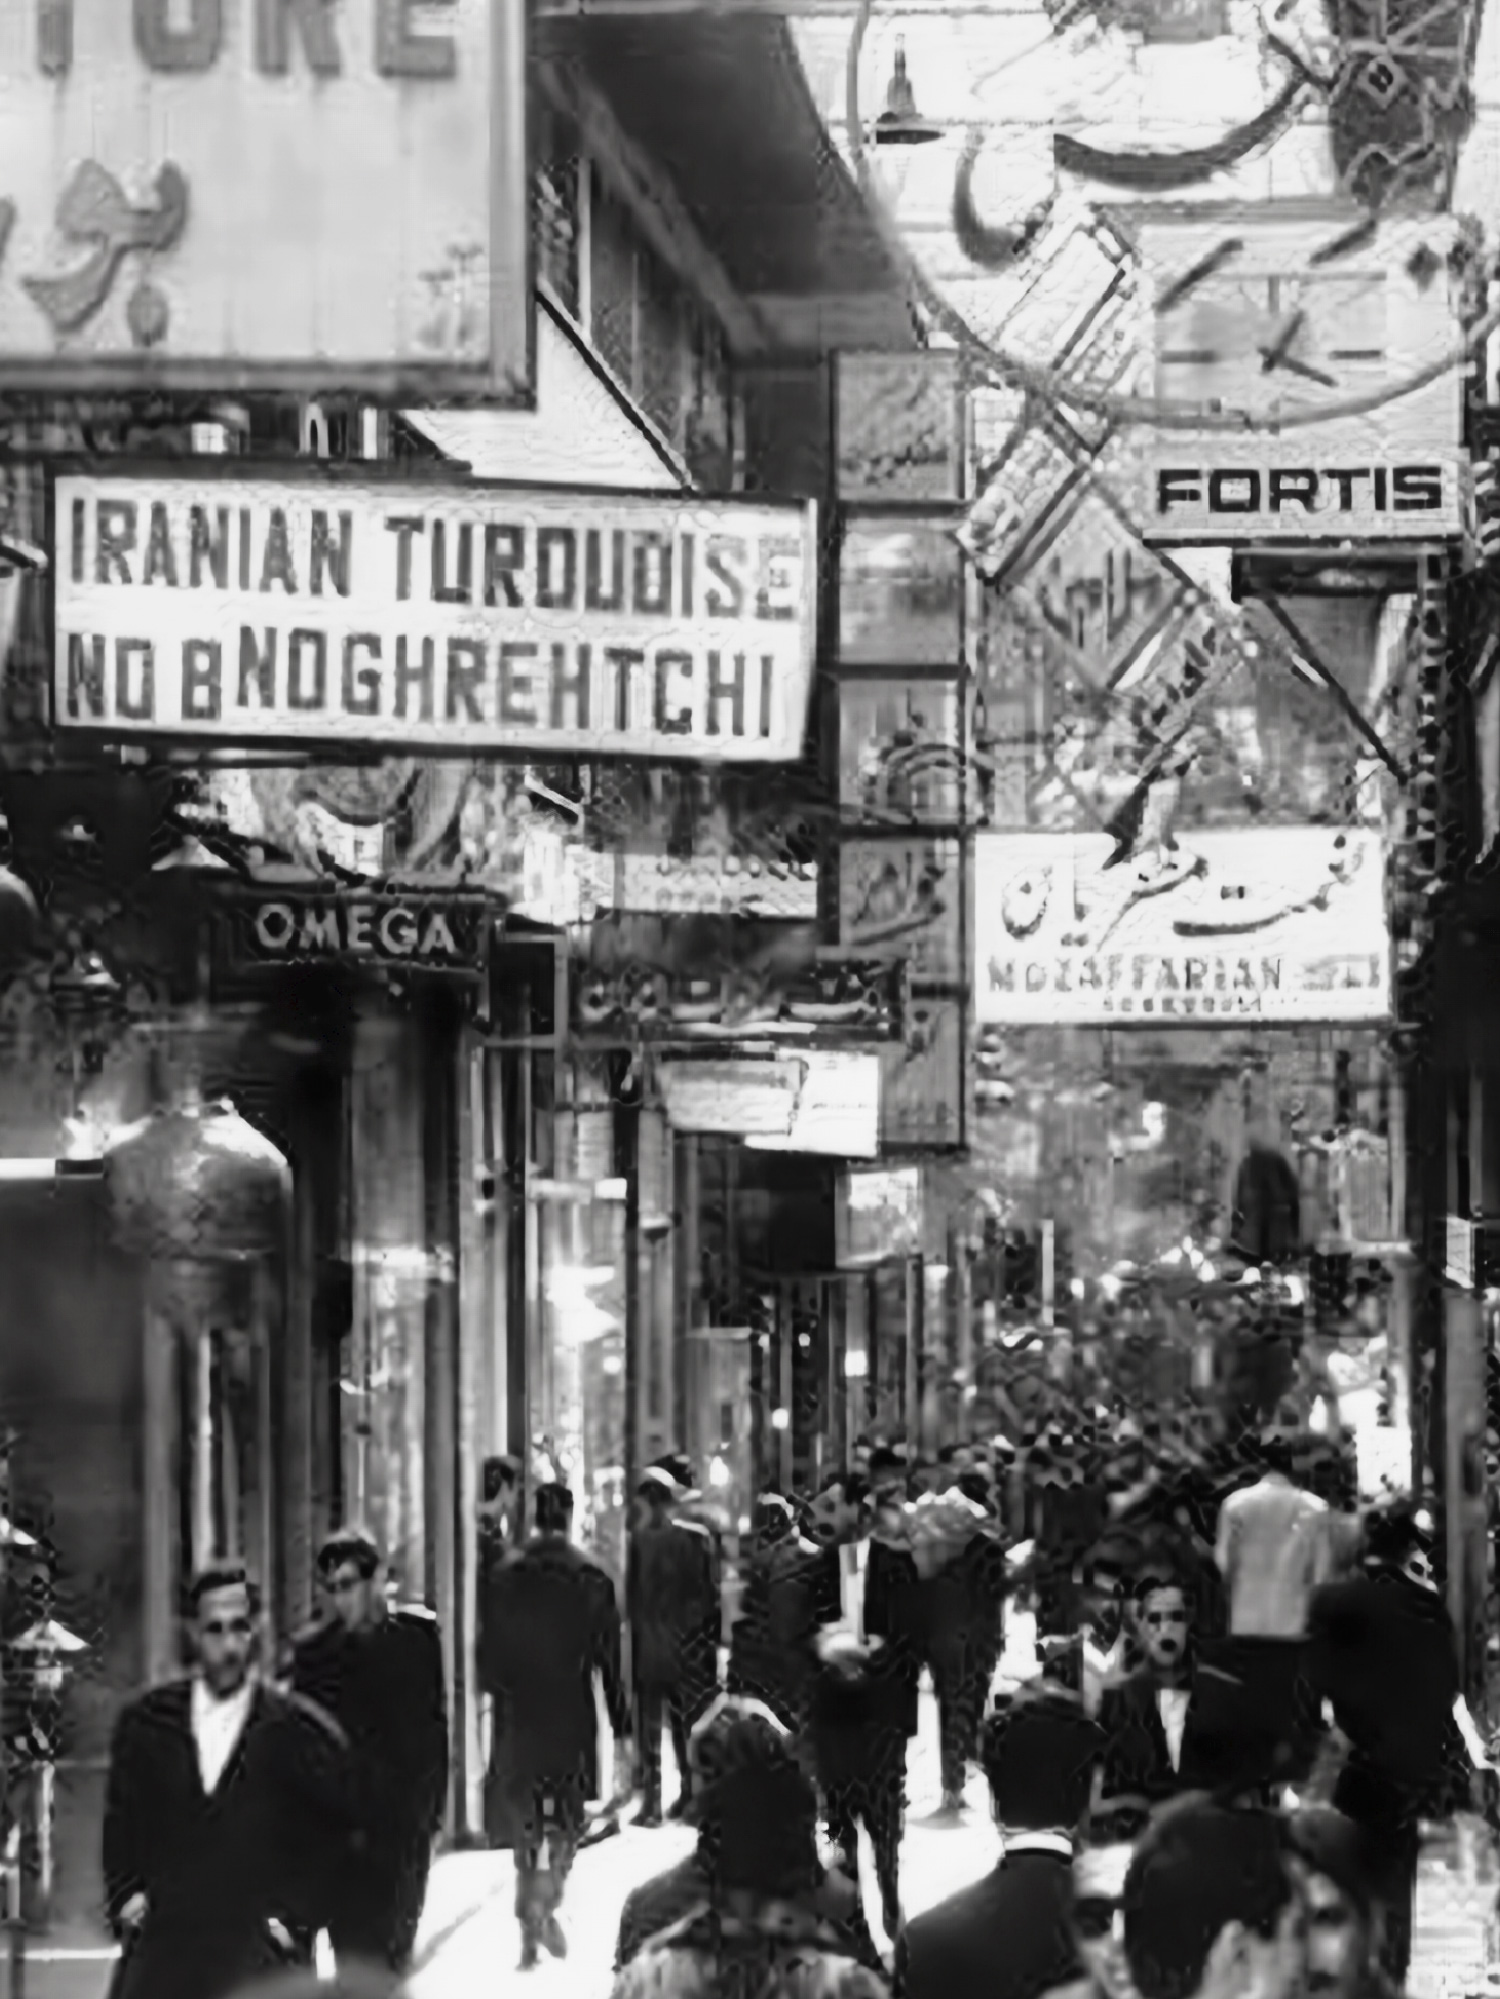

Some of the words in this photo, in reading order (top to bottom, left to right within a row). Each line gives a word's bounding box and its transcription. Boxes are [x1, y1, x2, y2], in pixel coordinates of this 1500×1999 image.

[1158, 466, 1443, 513] FORTIS
[71, 496, 352, 598] IRANIAN
[67, 632, 156, 721] NO
[255, 903, 456, 954] OMEGA
